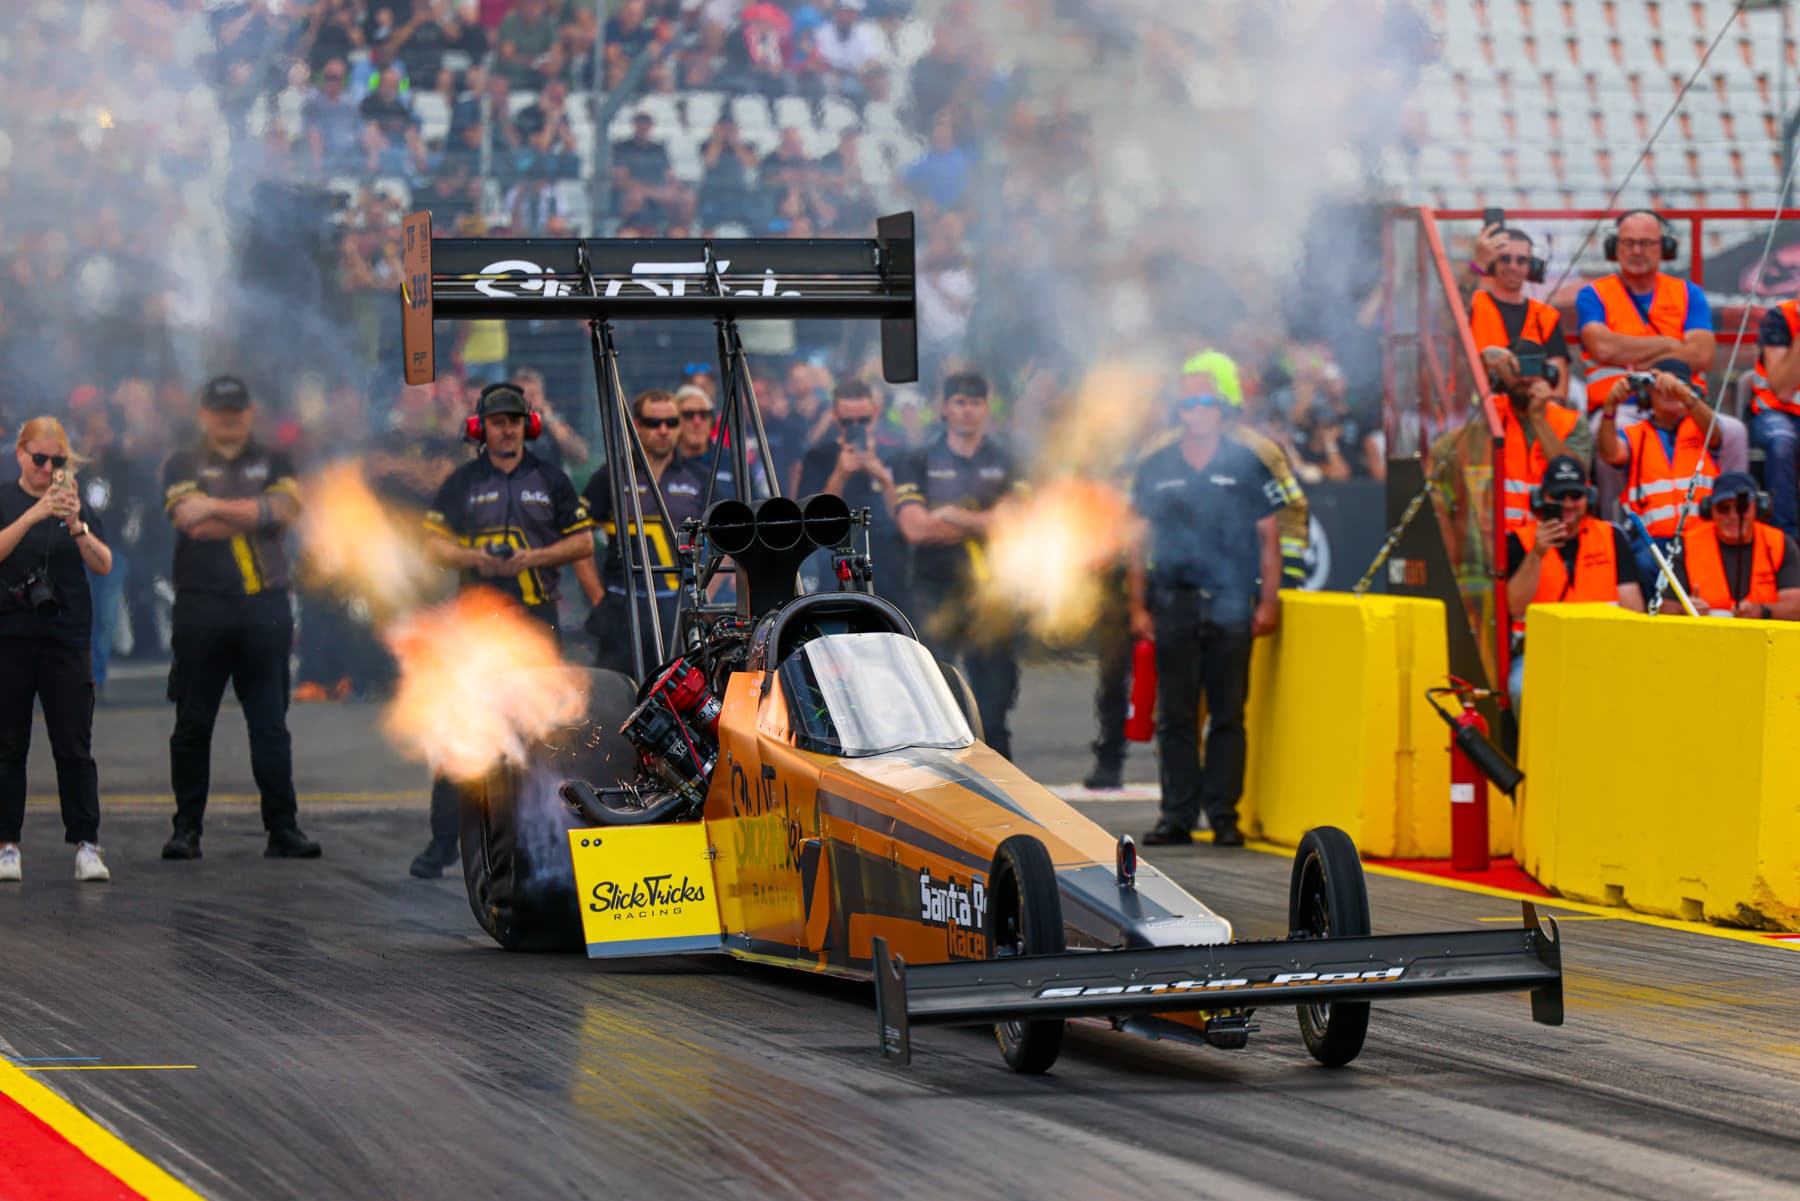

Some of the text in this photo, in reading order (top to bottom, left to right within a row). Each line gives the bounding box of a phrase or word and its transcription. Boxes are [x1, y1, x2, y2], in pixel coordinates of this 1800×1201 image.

[613, 907, 683, 921] RACING
[919, 873, 988, 929] Santa P
[948, 917, 987, 960] Race
